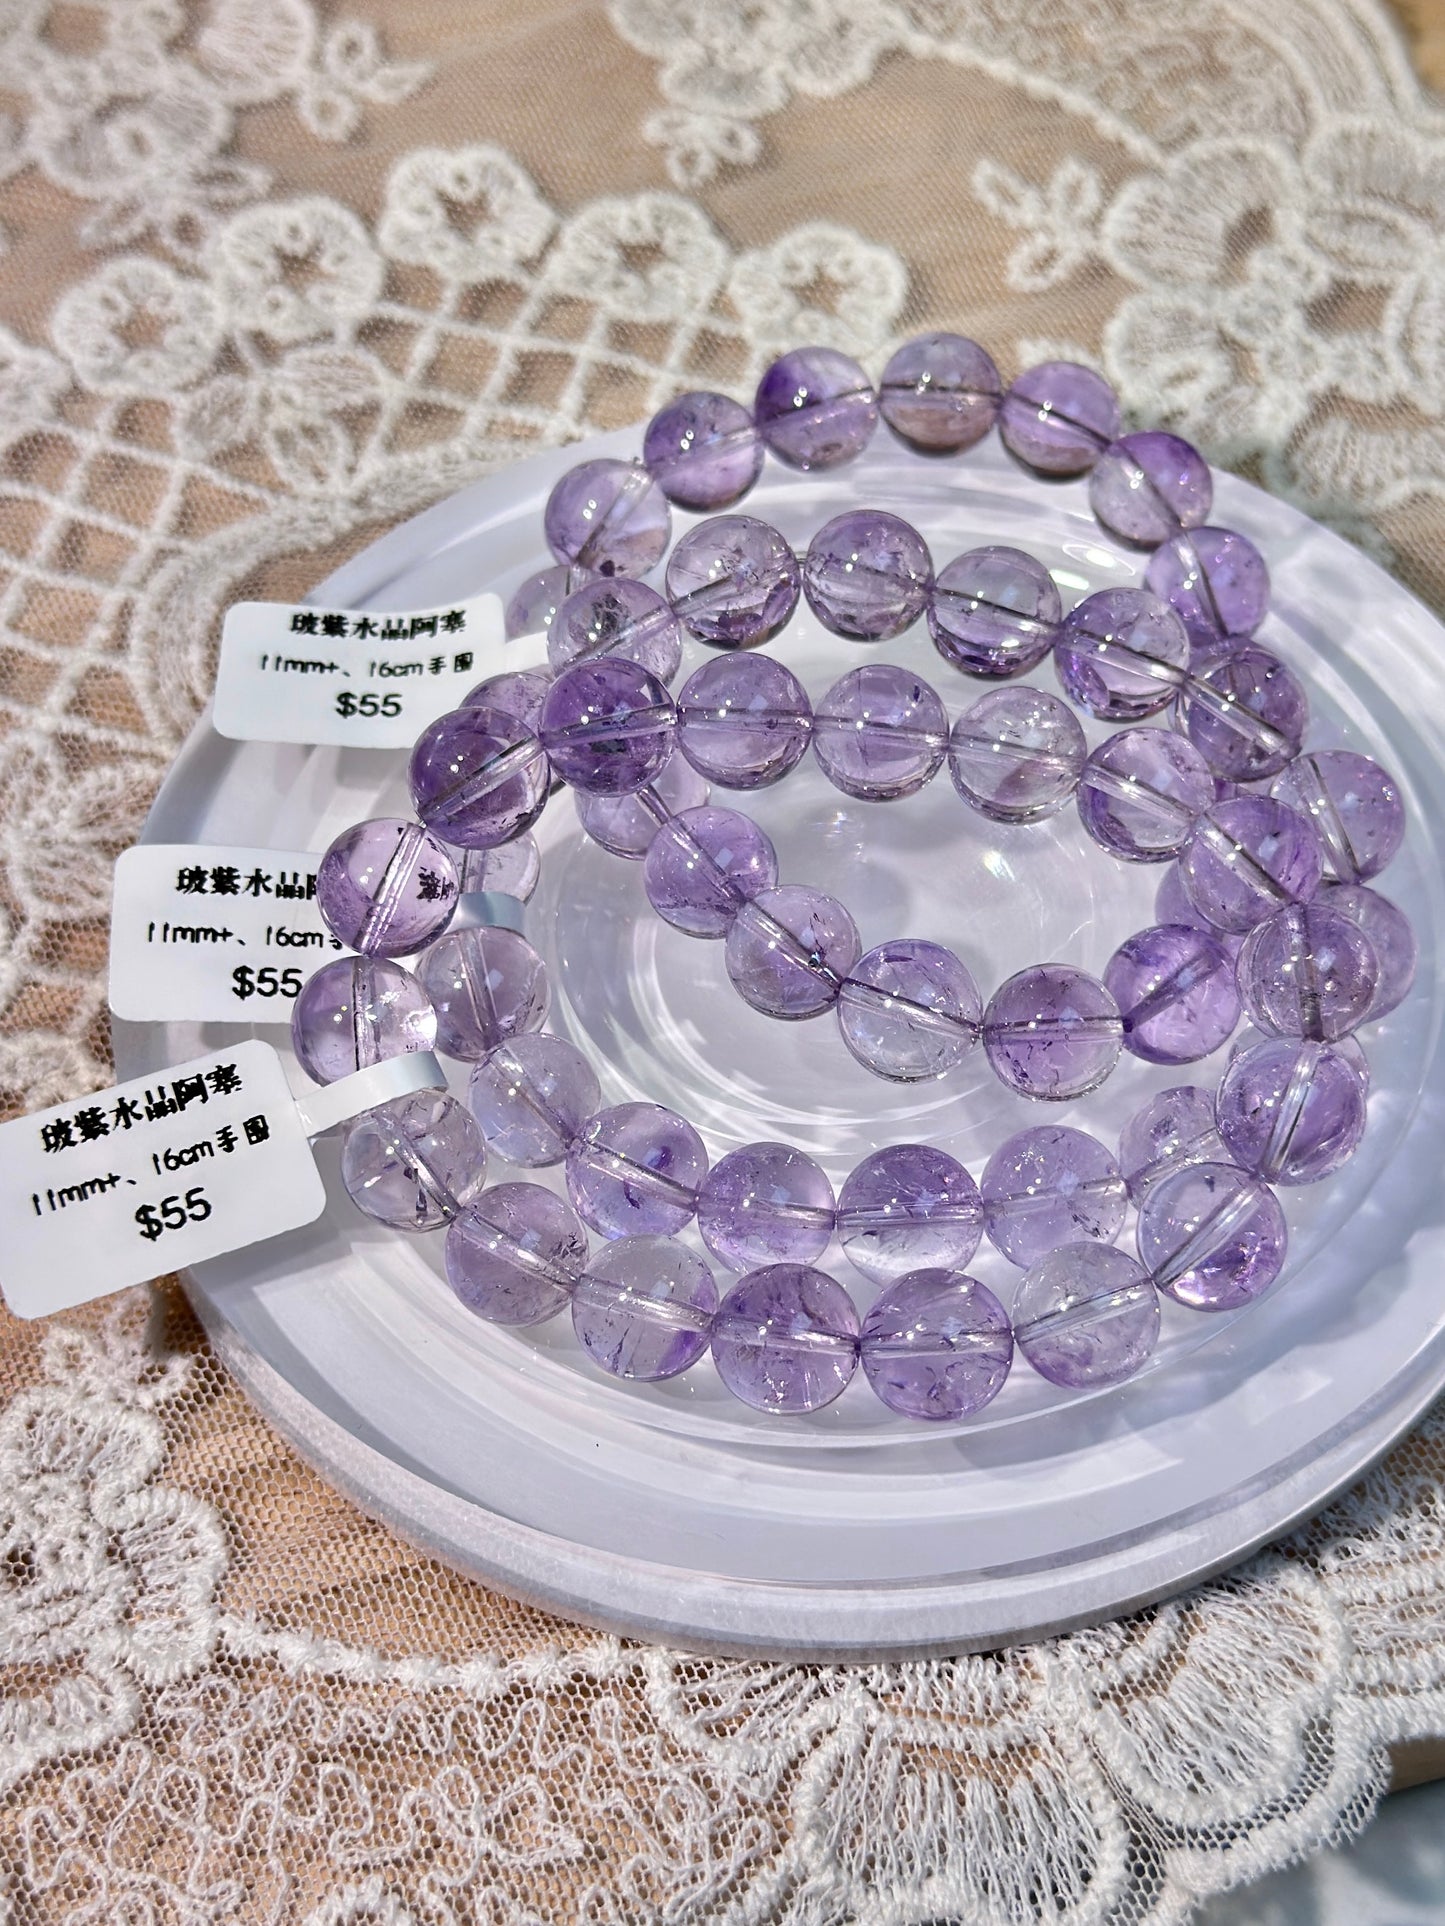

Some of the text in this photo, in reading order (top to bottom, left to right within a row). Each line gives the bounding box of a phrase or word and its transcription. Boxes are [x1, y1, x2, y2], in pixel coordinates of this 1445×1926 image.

[335, 692, 402, 719] $55
[232, 965, 303, 1000] $55
[135, 1186, 212, 1241] $55
